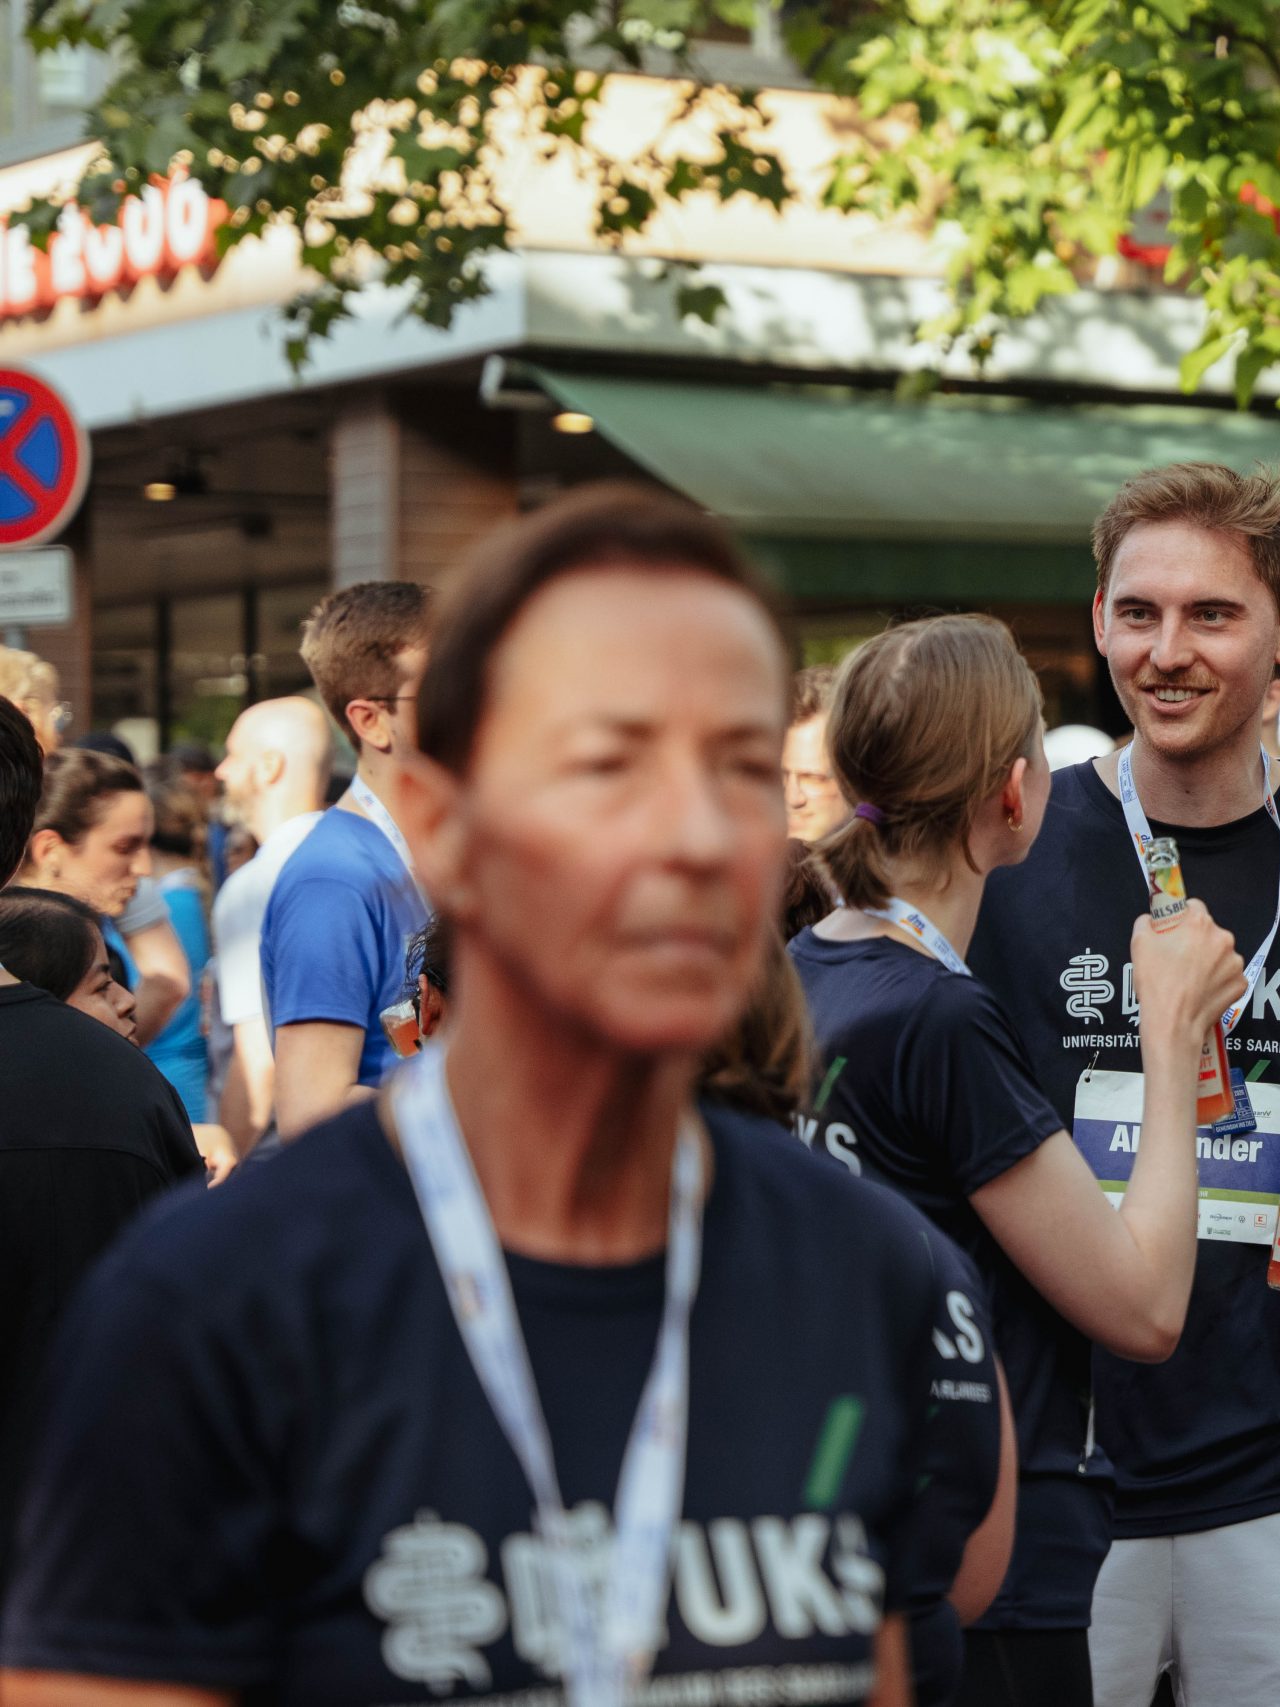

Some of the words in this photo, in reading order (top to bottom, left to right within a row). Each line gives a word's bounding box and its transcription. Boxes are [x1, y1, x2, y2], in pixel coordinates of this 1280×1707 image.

[1062, 1033, 1141, 1048] UNIVERSITÄT
[1225, 1038, 1242, 1051] ES
[1108, 1123, 1264, 1163] Alnder
